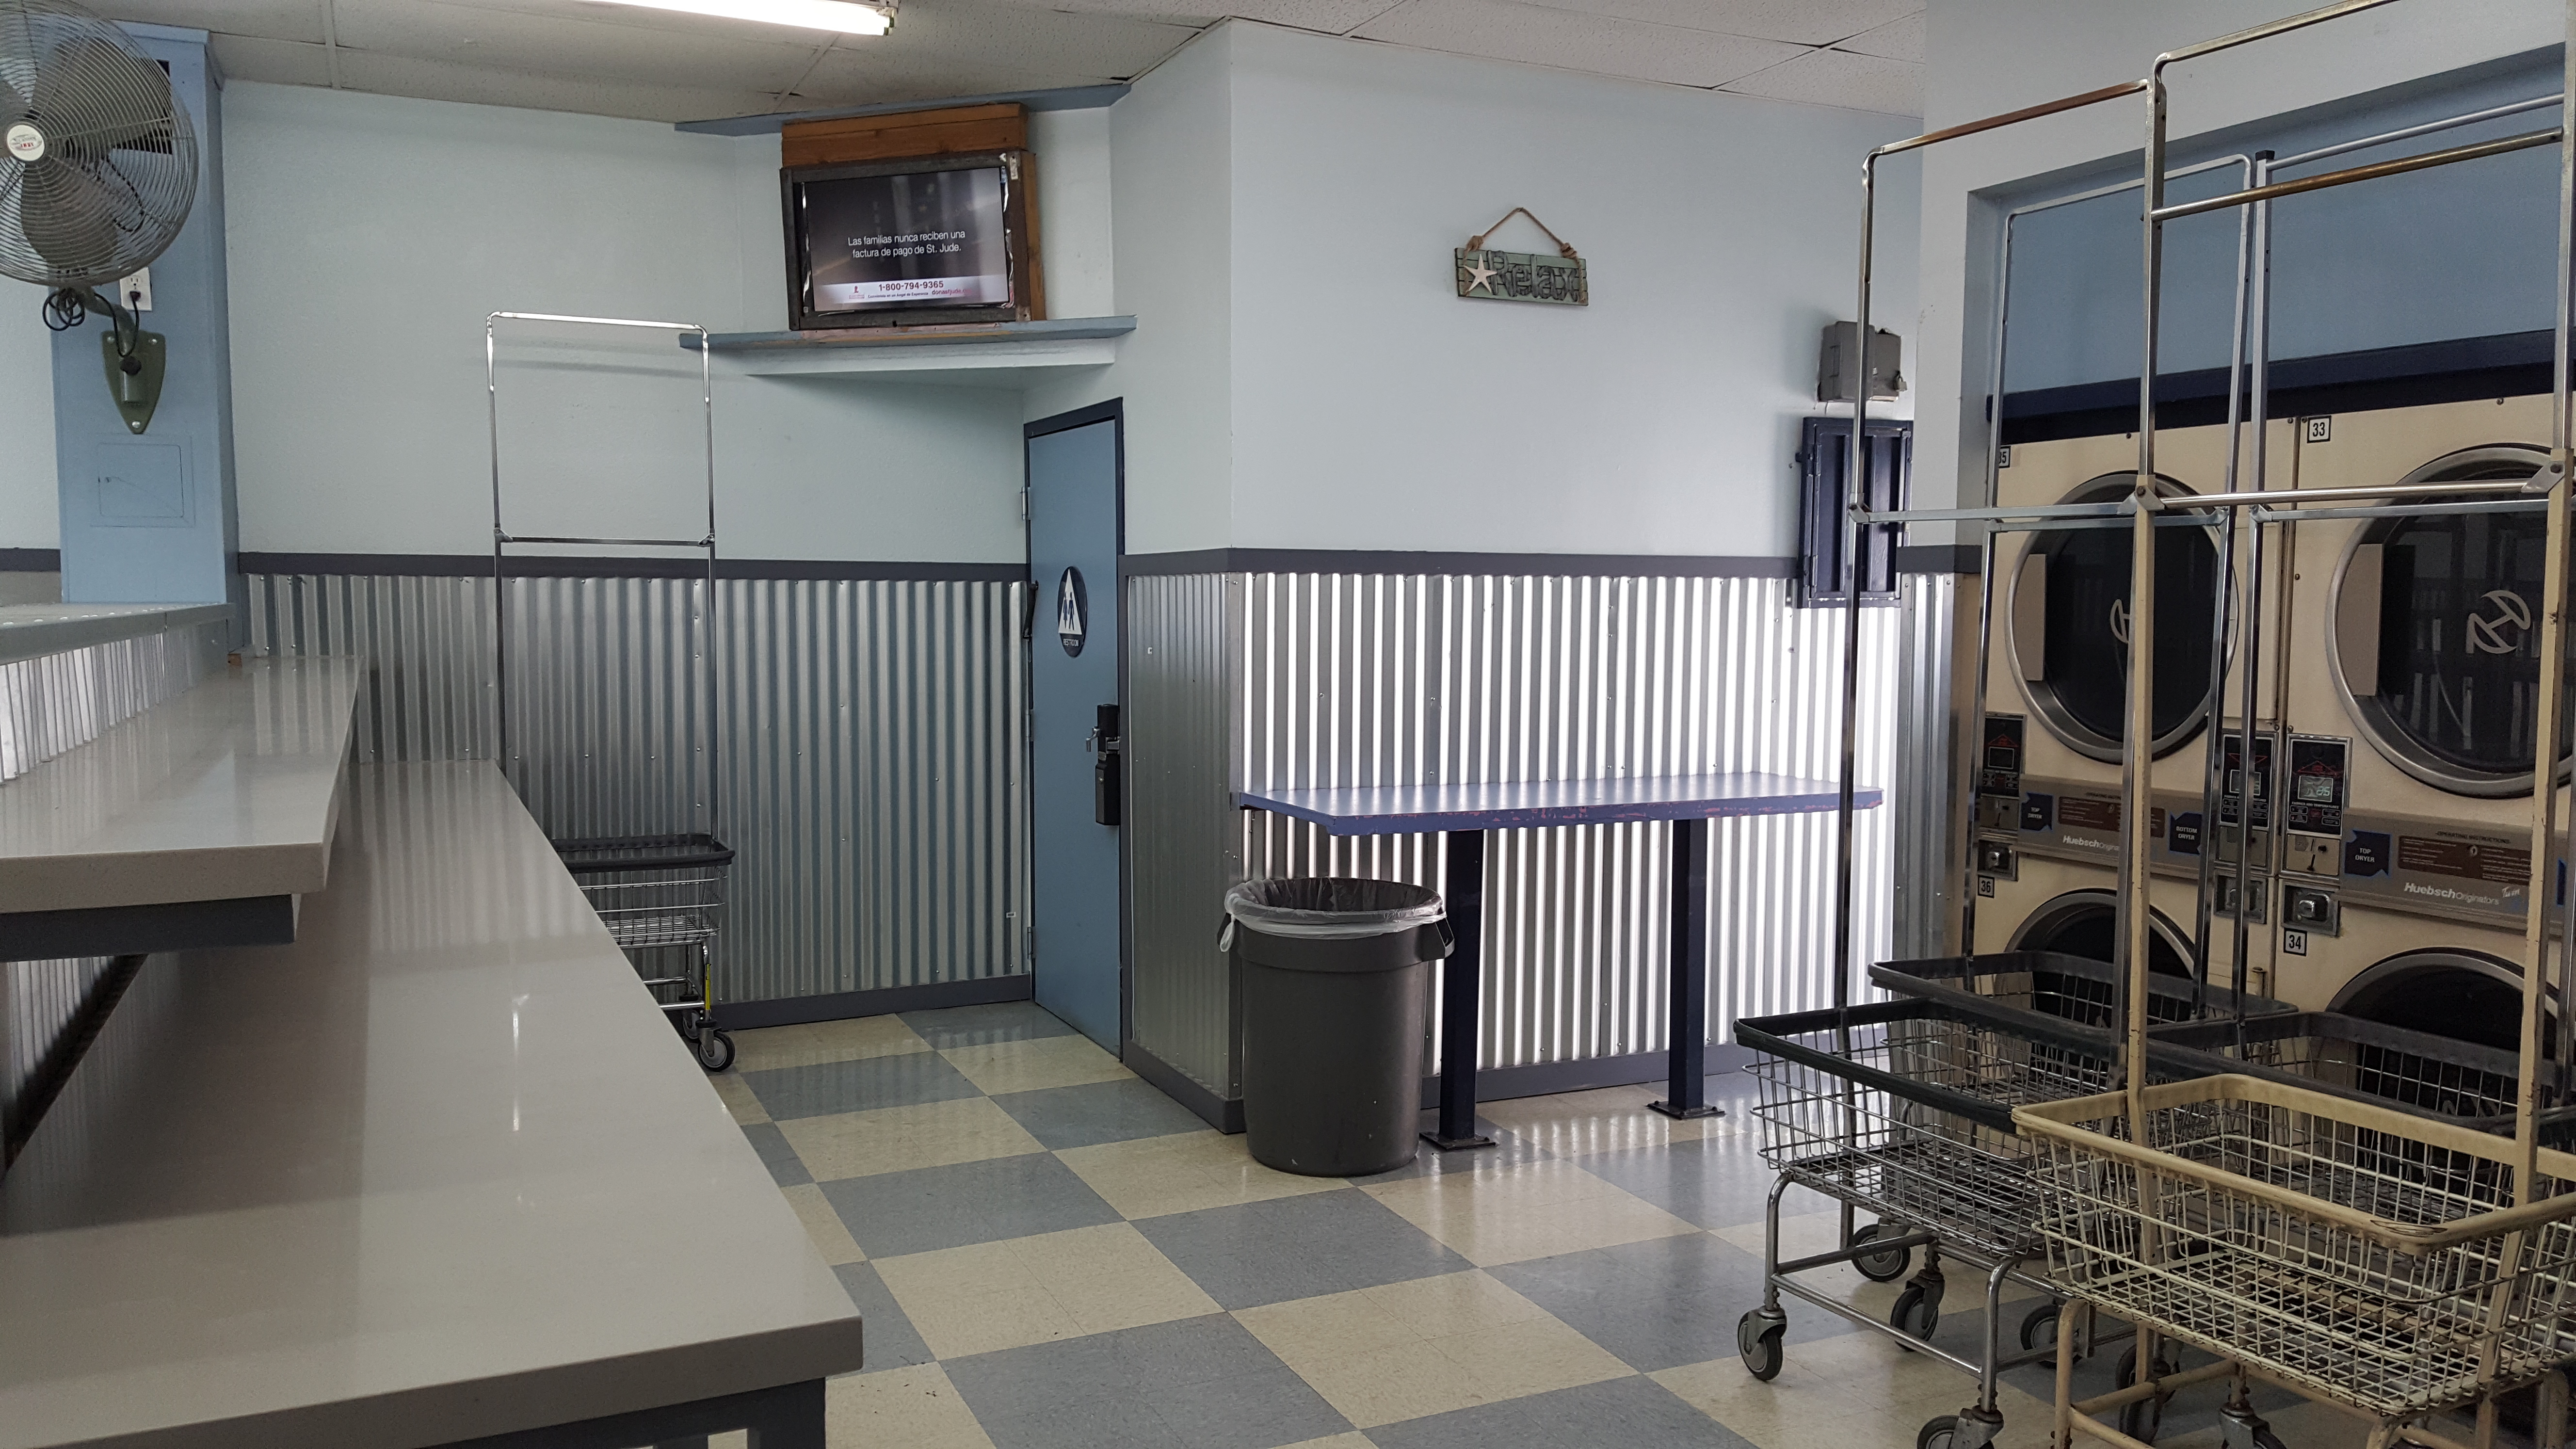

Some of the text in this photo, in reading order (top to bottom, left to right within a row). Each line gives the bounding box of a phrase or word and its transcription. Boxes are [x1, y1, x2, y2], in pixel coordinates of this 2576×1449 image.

[848, 231, 966, 246] Las familias nunca reciben una
[853, 242, 961, 258] factura de pago de St. Jude.
[1488, 250, 1579, 302] Relax
[878, 280, 944, 291] 1-800-794-9365
[2313, 422, 2325, 436] 33
[1063, 638, 1079, 646] RESTROOM
[1981, 880, 1991, 893] 36
[2502, 886, 2521, 898] Twin
[2289, 934, 2302, 950] 34
